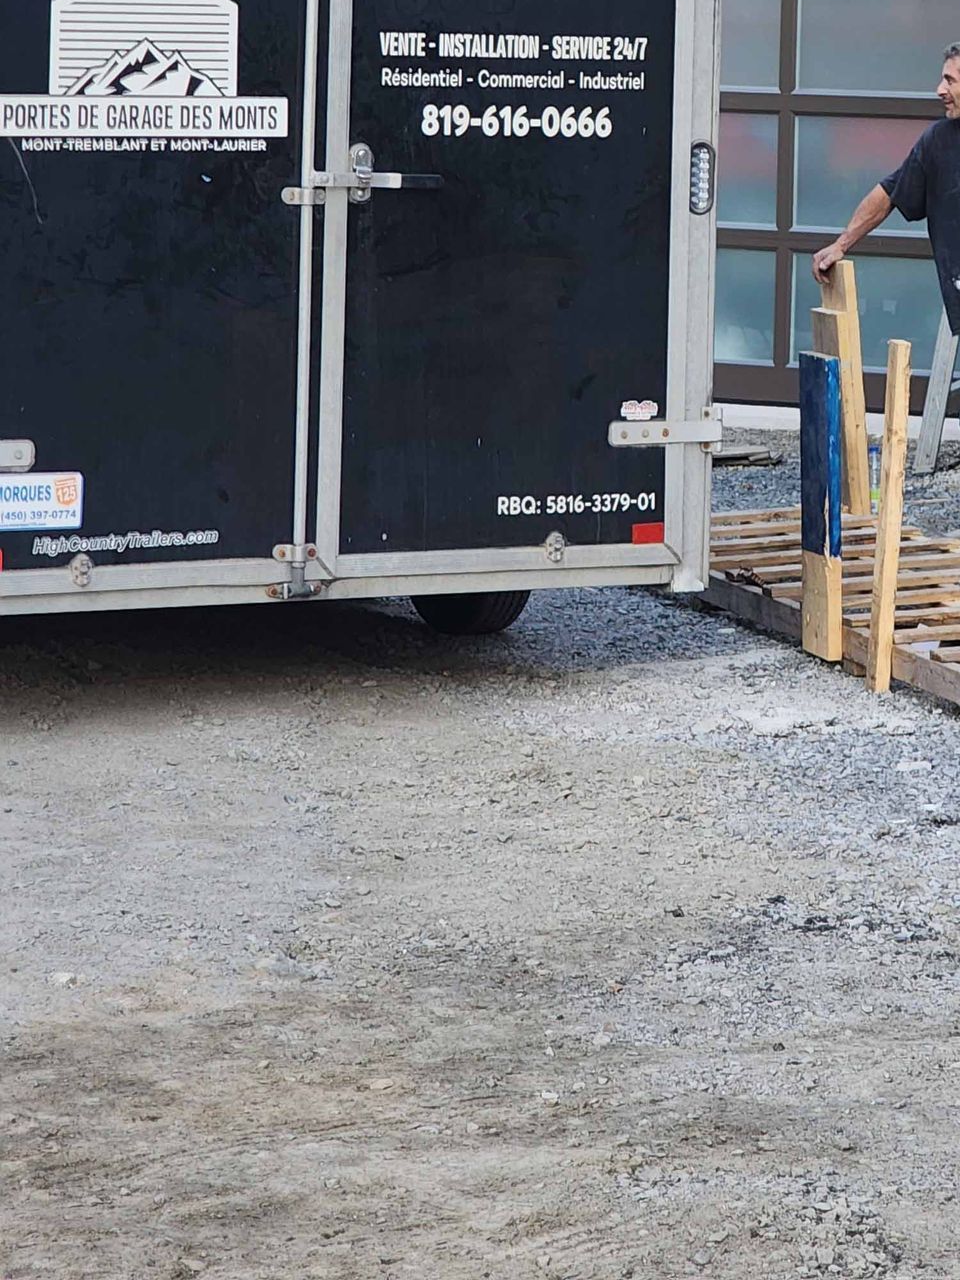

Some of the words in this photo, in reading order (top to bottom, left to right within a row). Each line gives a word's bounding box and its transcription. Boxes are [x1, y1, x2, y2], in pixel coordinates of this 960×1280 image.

[380, 32, 426, 57] VENTE
[439, 34, 540, 59] INSTALLATION
[552, 36, 611, 60] SERVICE
[613, 37, 648, 61] 24/7
[381, 67, 463, 88] Résidentiel
[478, 69, 565, 90] Commercial
[579, 71, 645, 91] Industriel
[3, 104, 71, 129] PORTES
[78, 104, 99, 129] DE
[106, 104, 173, 129] GARAGE
[180, 105, 212, 130] DES
[219, 106, 278, 130] MONTS
[421, 104, 613, 139] 819-616-0666
[21, 137, 149, 152] MONT-TREMBLANT
[150, 139, 167, 152] ET
[170, 139, 267, 152] MONT-LAURIER
[1, 512, 27, 522] (450)
[31, 510, 77, 520] 397-0774
[497, 496, 541, 515] RBQ:
[546, 492, 656, 513] 5816-3379-01
[33, 530, 218, 556] HighCountryTrailers.com
